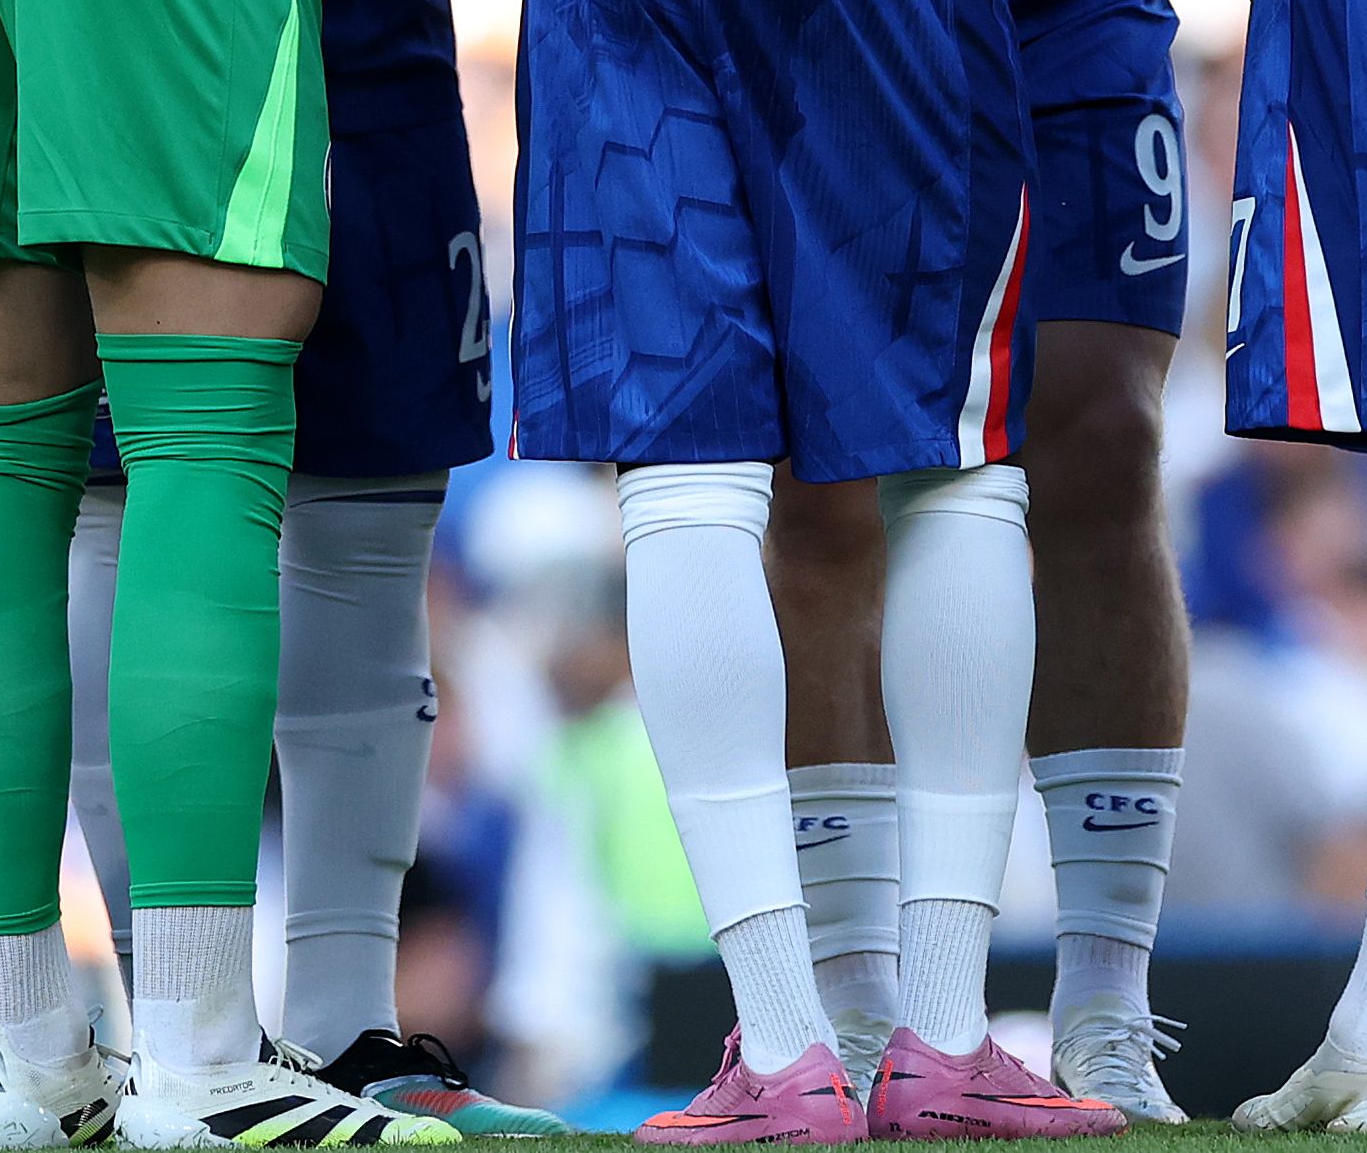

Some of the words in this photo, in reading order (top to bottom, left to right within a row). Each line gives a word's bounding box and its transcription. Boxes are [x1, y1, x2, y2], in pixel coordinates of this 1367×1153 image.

[1135, 113, 1183, 242] 9
[1085, 793, 1158, 814] CFC
[793, 816, 850, 832] FC
[209, 1080, 254, 1095] PREDATOR
